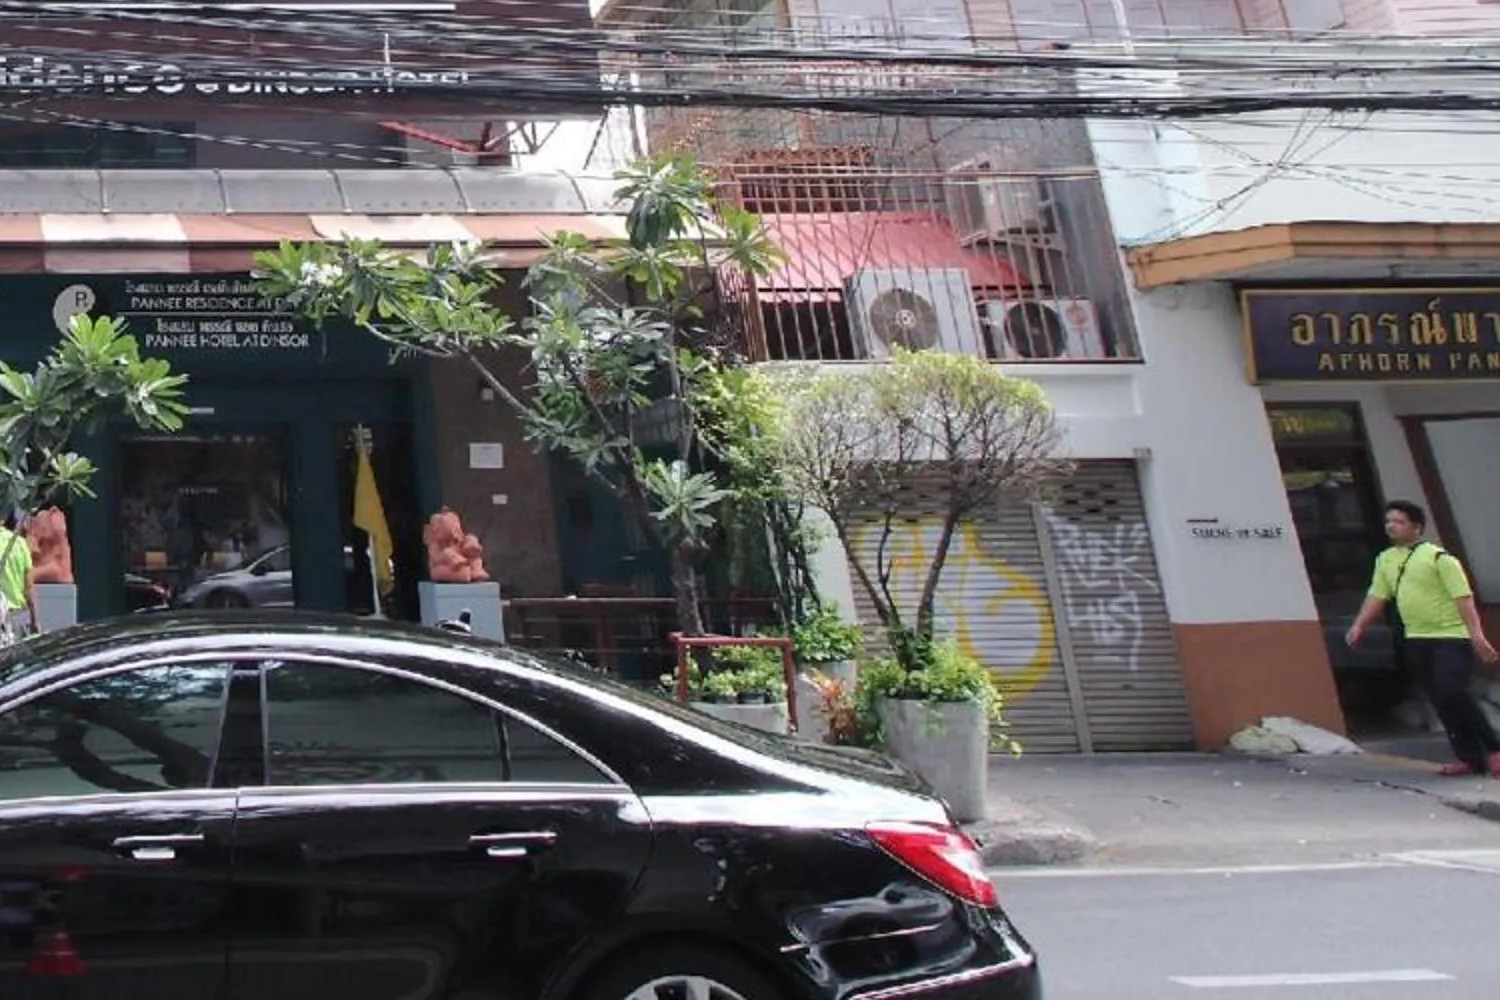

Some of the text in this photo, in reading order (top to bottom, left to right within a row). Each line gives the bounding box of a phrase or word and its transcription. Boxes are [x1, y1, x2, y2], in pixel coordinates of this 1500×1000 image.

[131, 296, 182, 309] PANNEE
[145, 334, 197, 348] PANNEE
[200, 334, 241, 348] HOTEL
